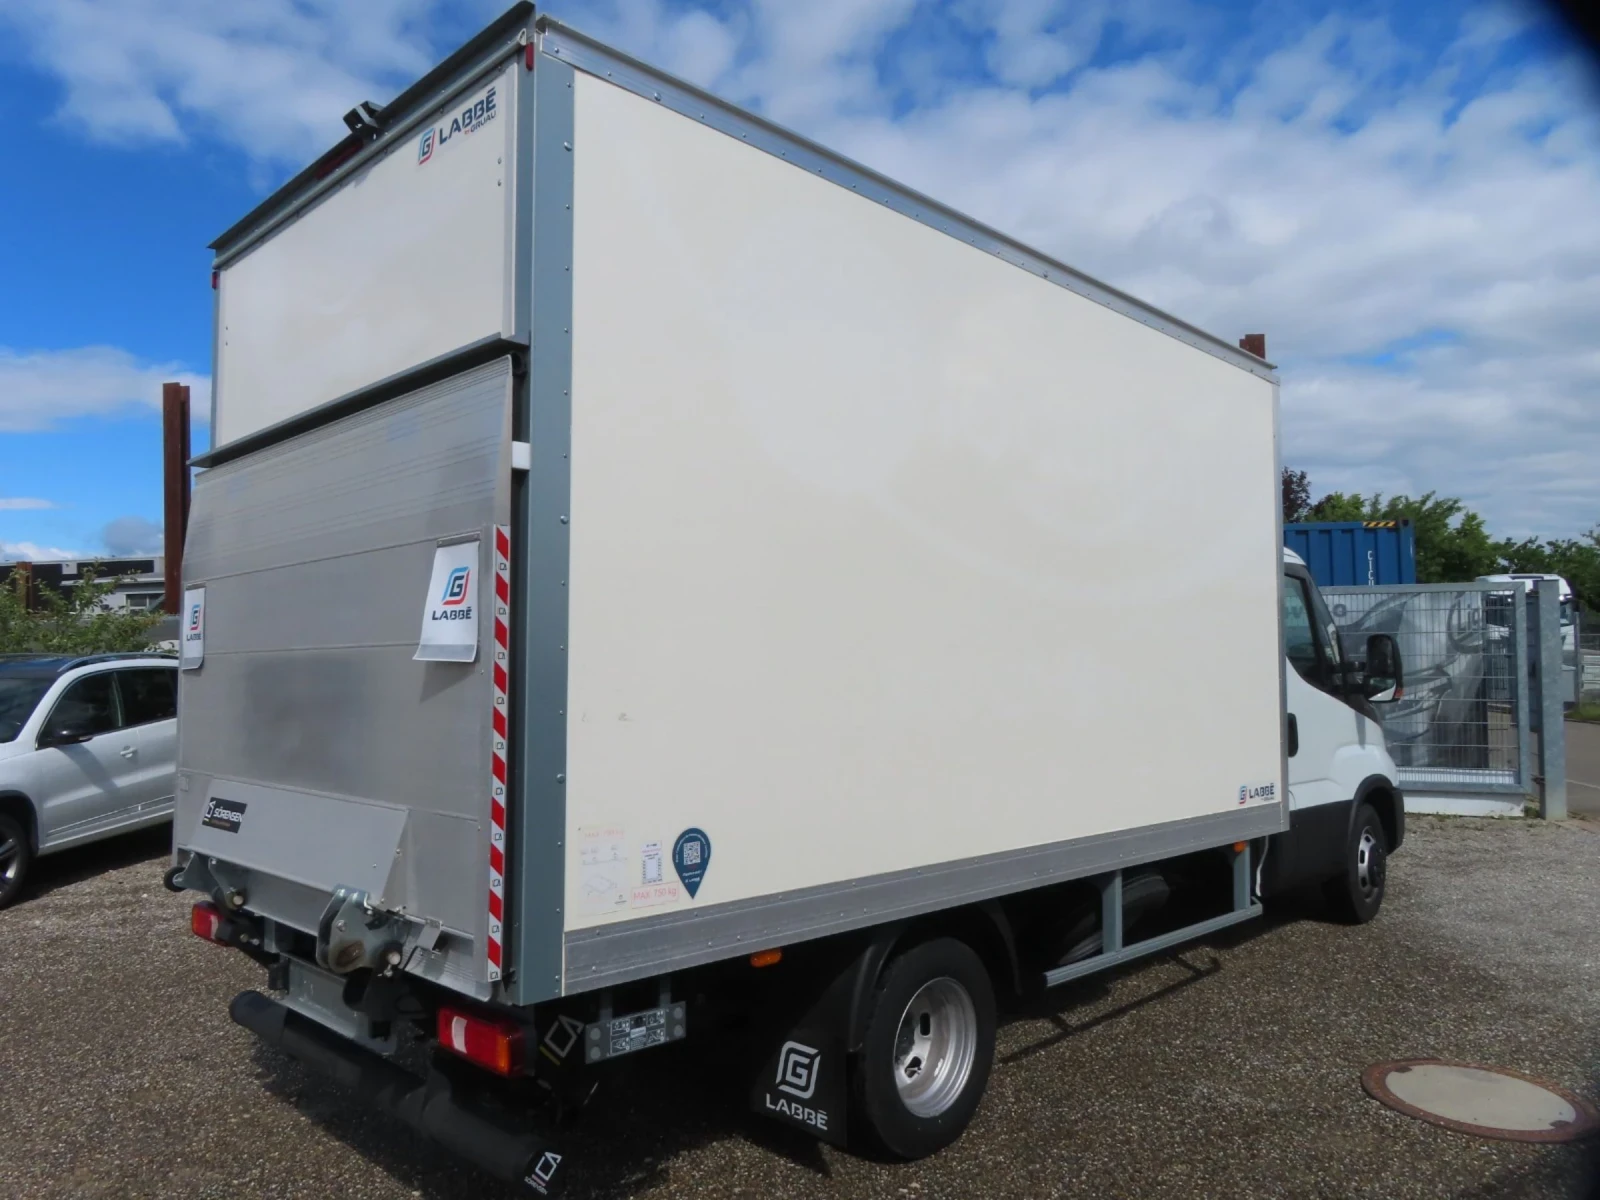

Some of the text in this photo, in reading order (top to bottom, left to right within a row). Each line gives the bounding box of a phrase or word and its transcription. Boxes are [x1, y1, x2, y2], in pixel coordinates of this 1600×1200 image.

[439, 86, 497, 145] LABBÉ
[470, 110, 497, 133] GRUAU
[431, 606, 473, 621] LABBÉ
[633, 887, 677, 900] MAX 750 kg
[765, 1093, 828, 1131] LABBÉ
